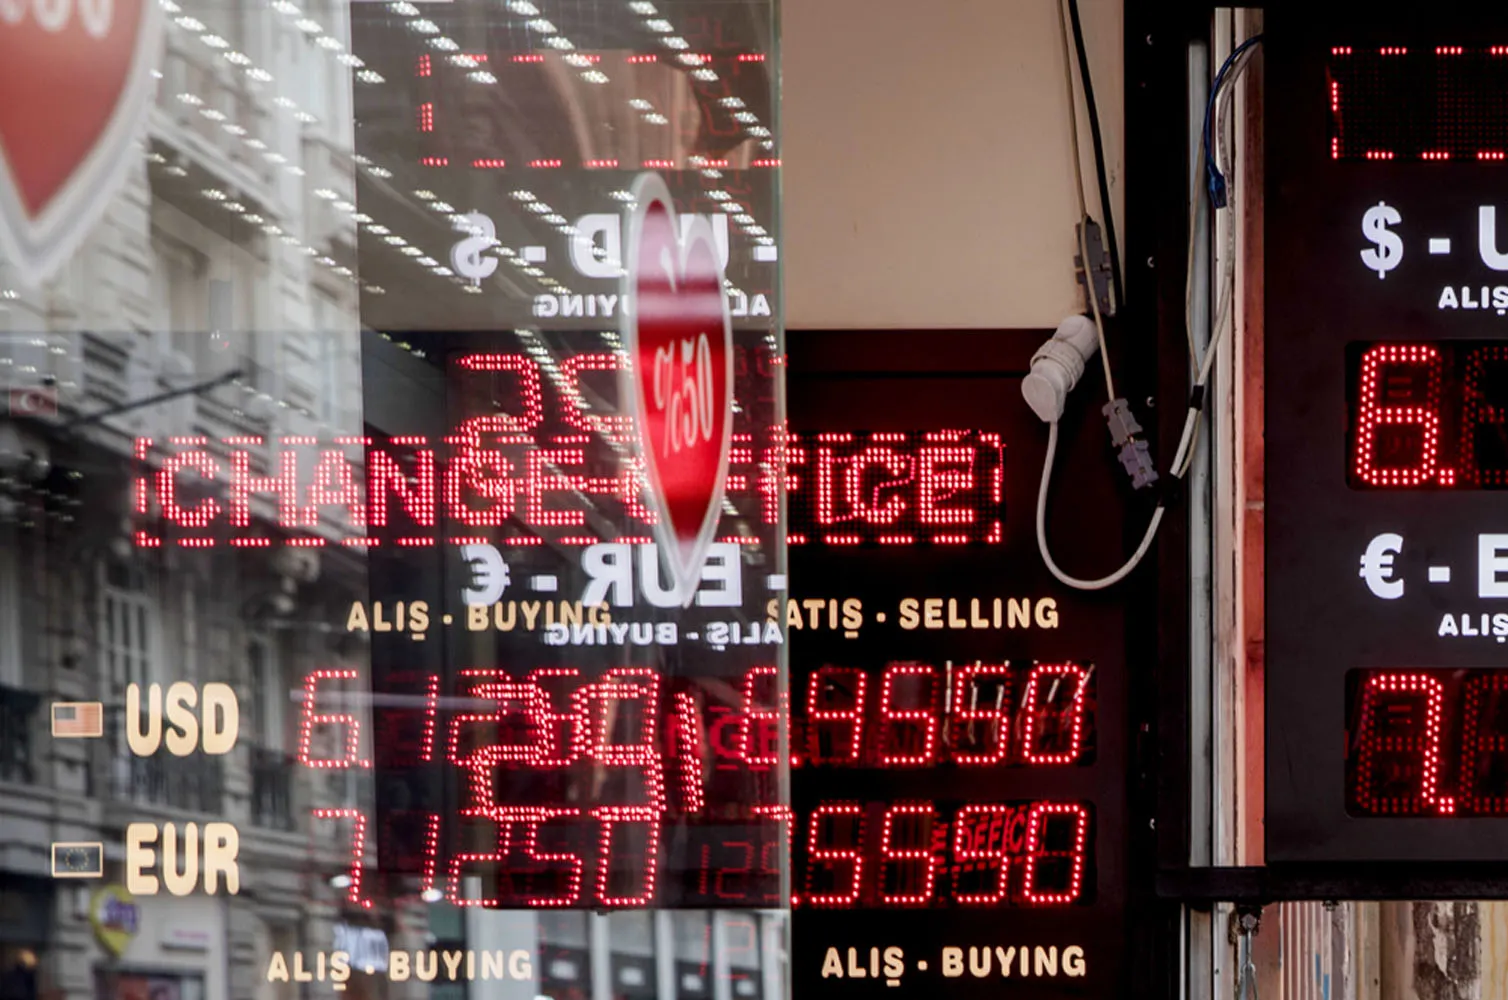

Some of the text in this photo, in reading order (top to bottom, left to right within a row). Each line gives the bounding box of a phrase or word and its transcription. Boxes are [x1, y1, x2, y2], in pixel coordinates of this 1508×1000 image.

[1360, 201, 1403, 279] $
[653, 332, 714, 459] %50
[157, 449, 586, 528] CHANGE
[1359, 533, 1404, 599] €
[346, 600, 429, 641] ALIŞ
[467, 600, 612, 632] BUYING
[900, 597, 1059, 629] SELLING
[126, 682, 240, 756] USD
[126, 822, 240, 895] EUR
[267, 951, 350, 991] ALIŞ
[388, 951, 533, 983] BUYING
[820, 946, 903, 986] ALIŞ
[941, 946, 1086, 978] BUYING
